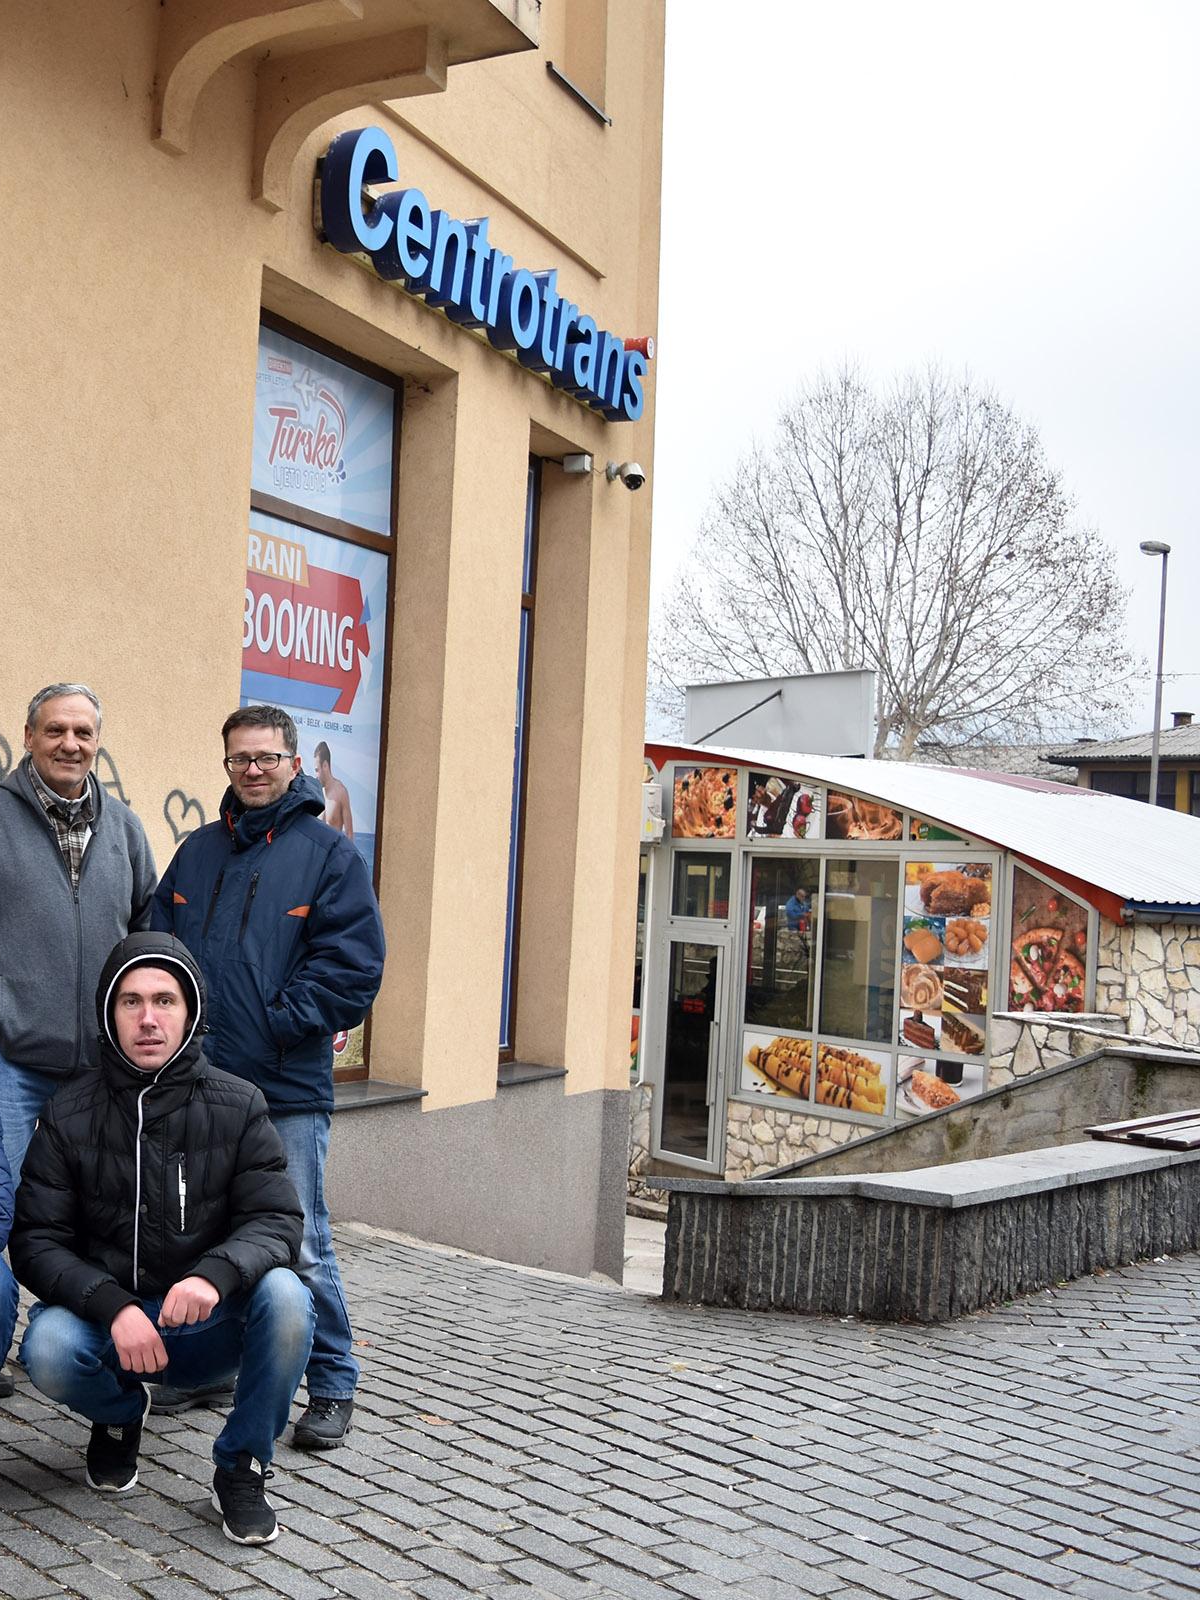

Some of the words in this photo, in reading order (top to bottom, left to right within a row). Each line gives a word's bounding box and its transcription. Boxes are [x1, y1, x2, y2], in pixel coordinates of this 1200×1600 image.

[348, 126, 648, 422] Centrotrans
[268, 406, 337, 471] Turska
[247, 534, 302, 581] RANI
[242, 588, 354, 671] BOOKING
